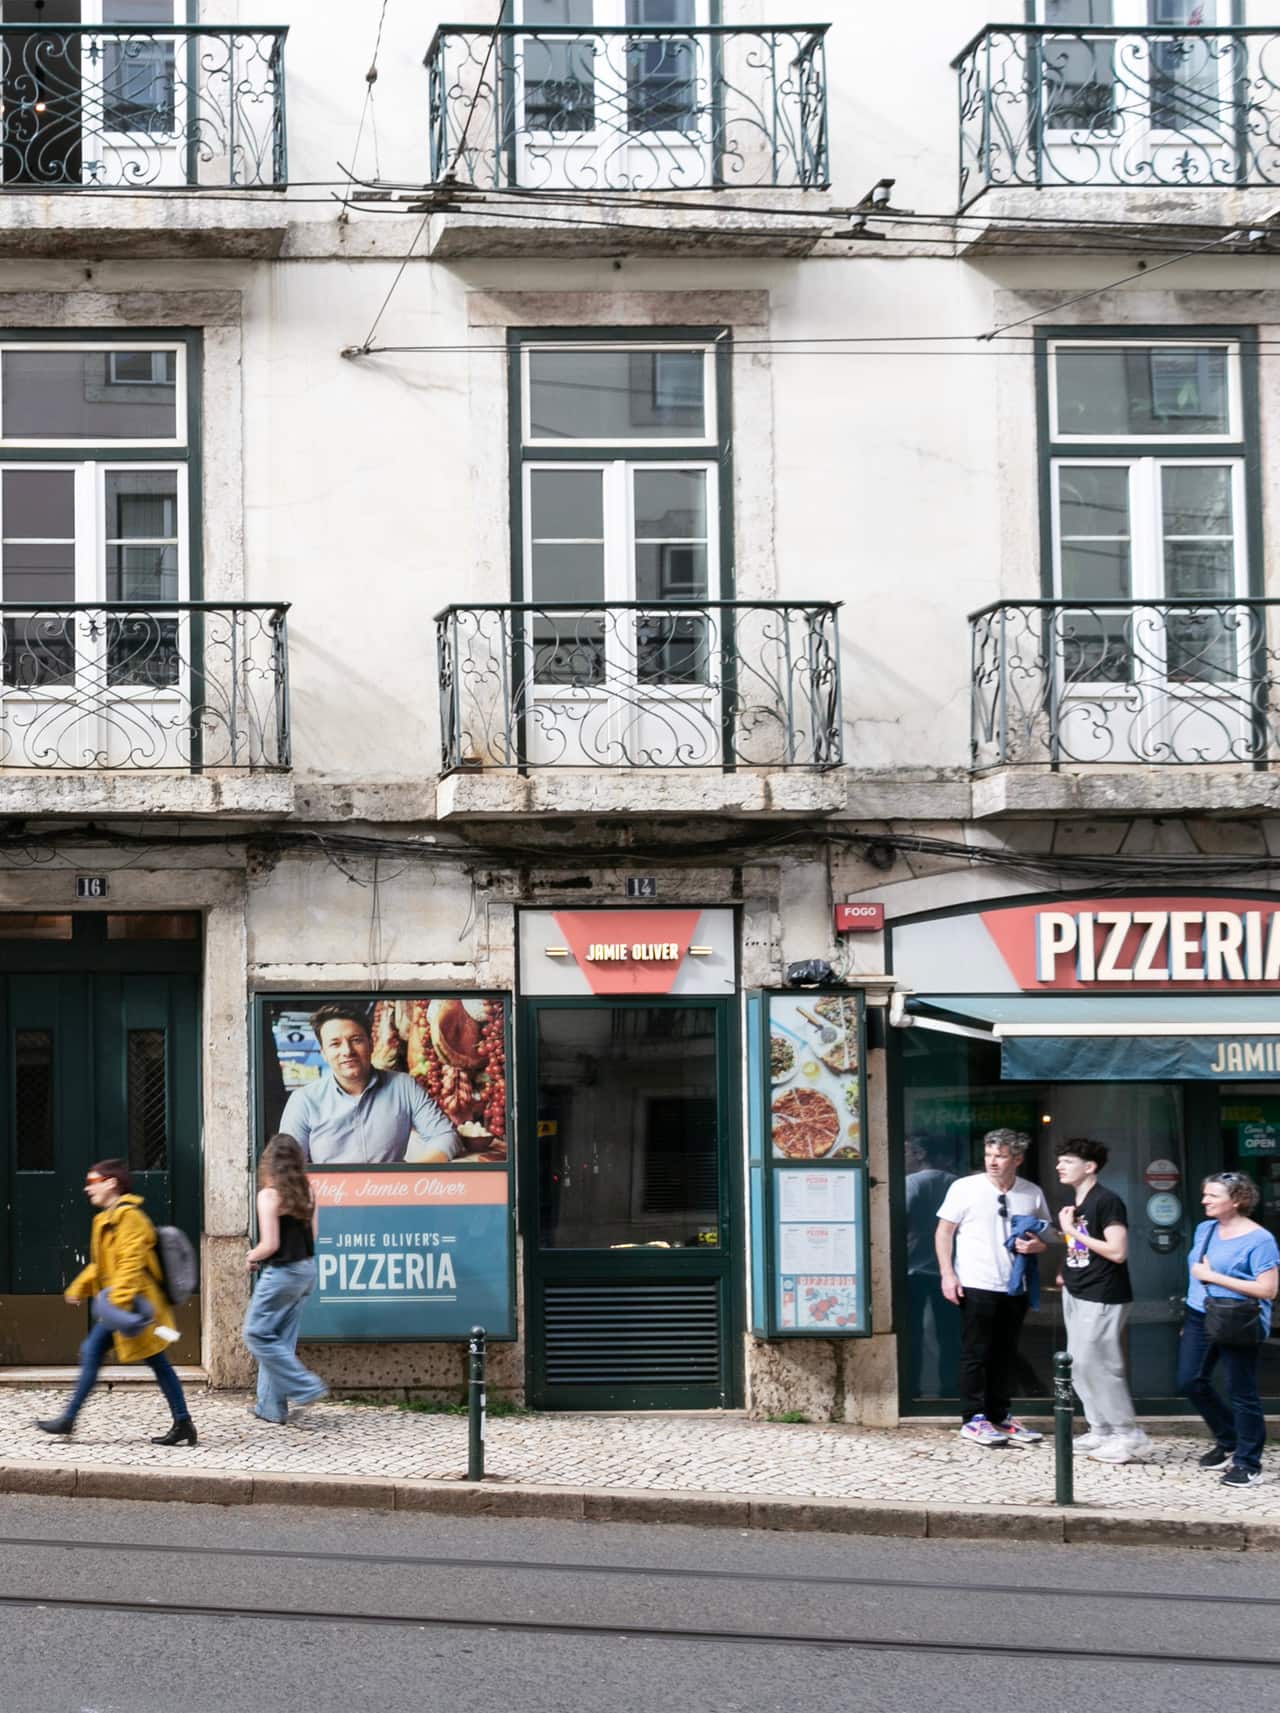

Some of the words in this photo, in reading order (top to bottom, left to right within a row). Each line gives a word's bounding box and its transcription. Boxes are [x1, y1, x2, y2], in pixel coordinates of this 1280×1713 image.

[83, 878, 101, 897] 16
[633, 878, 652, 897] 14
[844, 907, 877, 917] FOGO
[586, 944, 627, 961] JAMIE
[632, 943, 679, 961] OLIVER
[1245, 1138, 1276, 1149] OPEN
[355, 1178, 409, 1197] Jamie
[413, 1177, 466, 1196] Oliver
[336, 1234, 376, 1248] JAMIE
[383, 1233, 440, 1248] OLIVER'S
[319, 1252, 457, 1291] PIZZERIA
